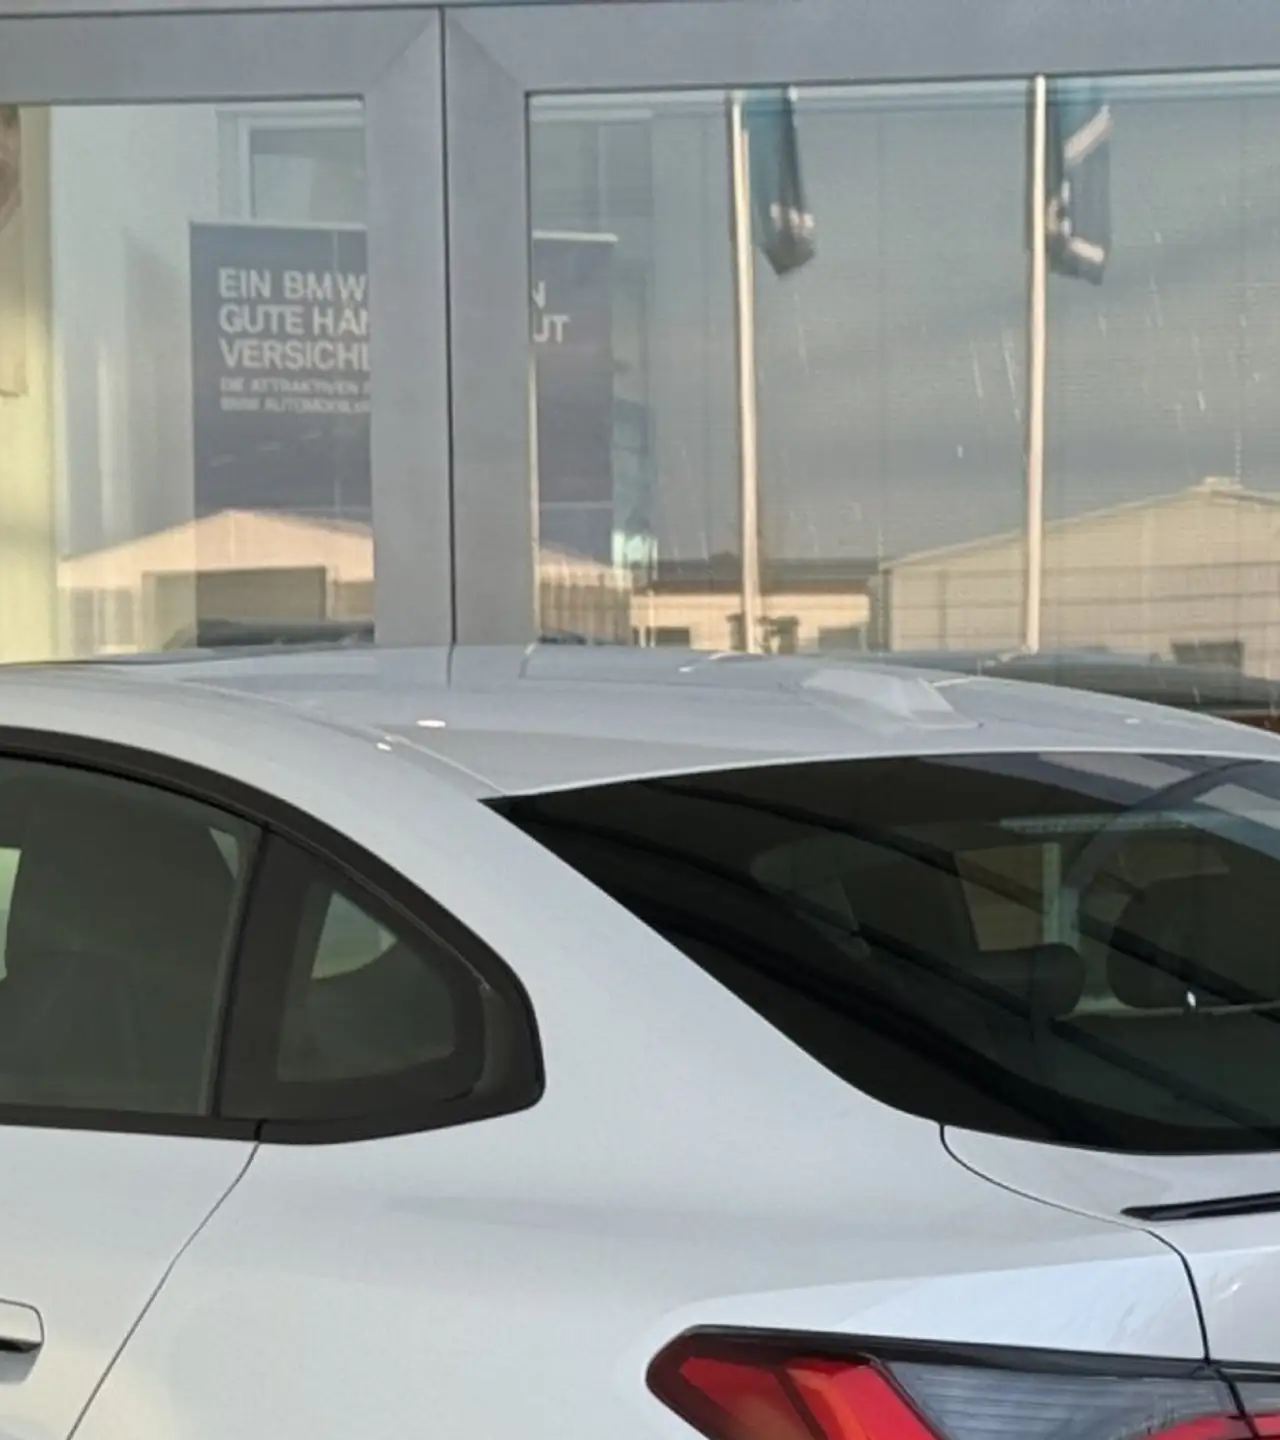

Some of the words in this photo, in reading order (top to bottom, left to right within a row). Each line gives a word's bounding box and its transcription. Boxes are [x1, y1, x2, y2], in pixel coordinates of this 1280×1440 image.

[219, 267, 272, 299] EIN
[283, 269, 367, 302] BMW
[219, 302, 305, 335] GUTE
